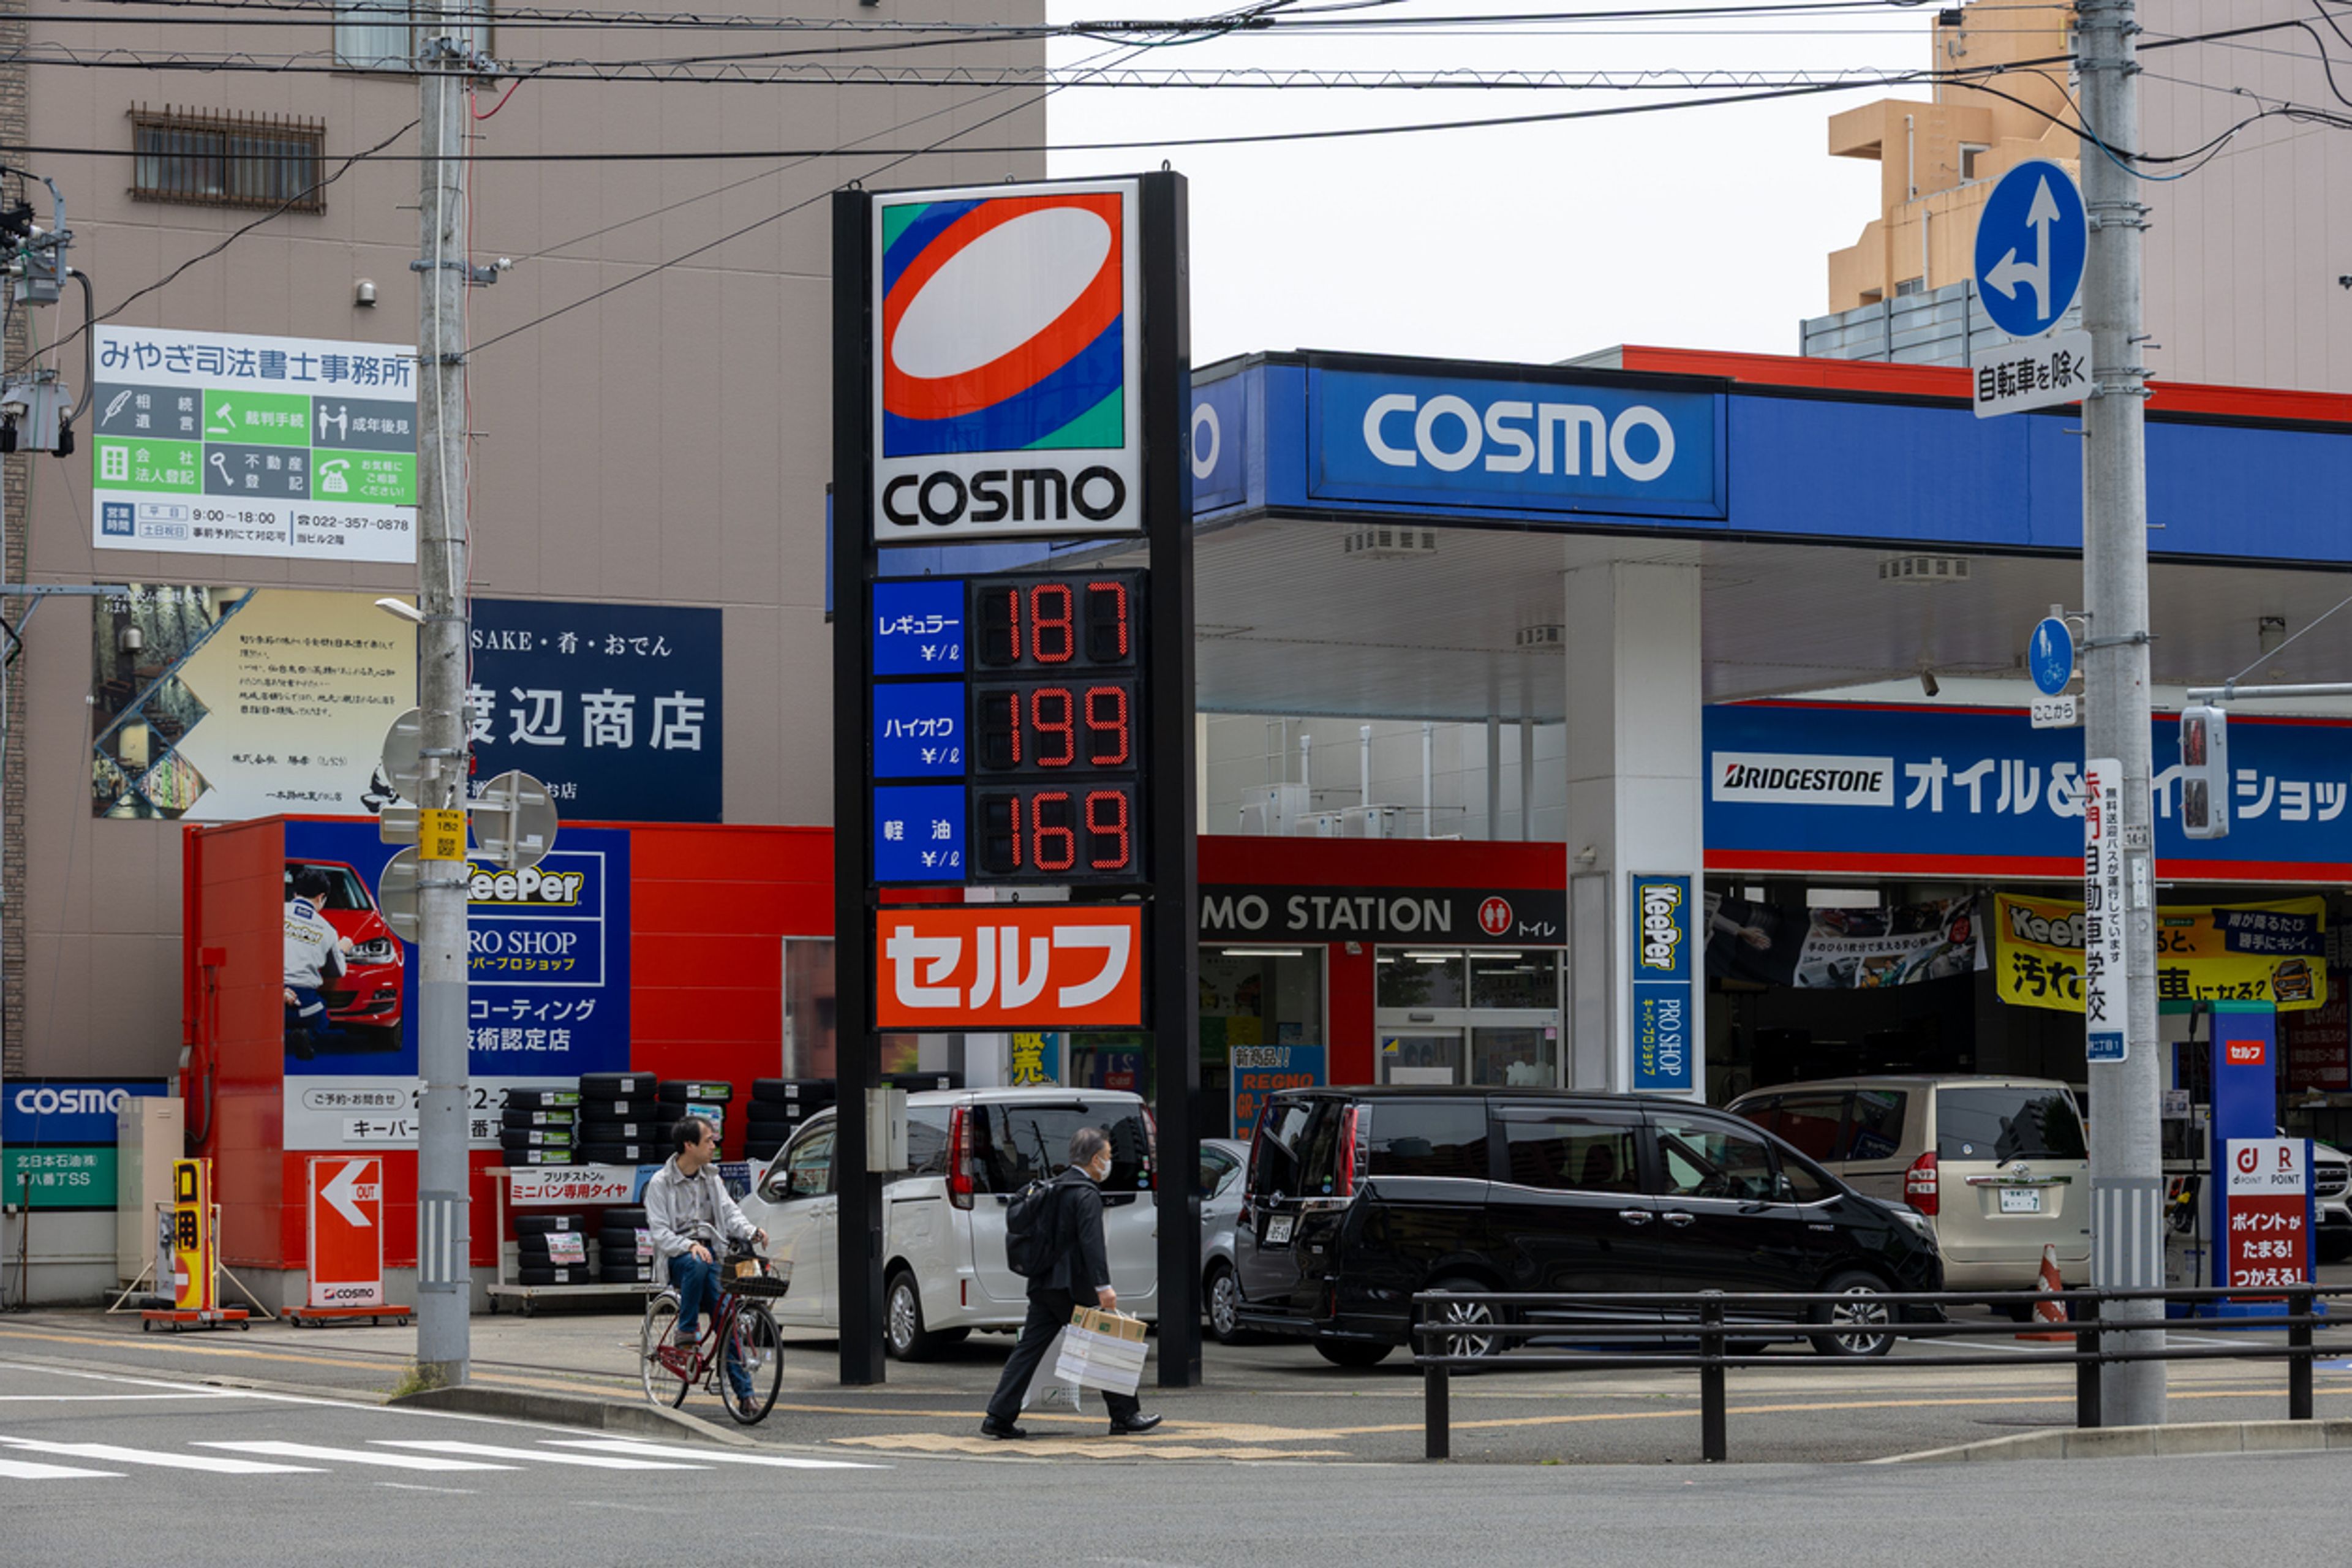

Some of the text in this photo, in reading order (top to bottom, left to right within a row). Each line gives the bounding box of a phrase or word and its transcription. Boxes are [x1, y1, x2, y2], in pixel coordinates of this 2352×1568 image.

[100, 339, 410, 388] みやぎ司法書士事務所
[1978, 349, 2085, 402] 自転車を除く
[246, 410, 304, 428] 裁判手続
[352, 418, 410, 434] 成年後見
[1362, 393, 1676, 481] COSMO
[135, 448, 194, 466] 会社
[246, 453, 303, 472] 不動産
[361, 460, 403, 472] お気軽に
[135, 467, 195, 485] 法人登記
[246, 473, 303, 491] 登記
[366, 473, 398, 484] ご相談
[882, 465, 1126, 527] COSMO
[312, 515, 409, 532] 022-357-0878
[879, 615, 959, 636] レギュラー
[1009, 581, 1128, 663] 187
[2033, 703, 2073, 722] ここから
[884, 718, 954, 738] ハイオク
[1010, 686, 1128, 767] 199
[1723, 763, 1883, 793] BRIDGESTONE
[884, 819, 951, 841] 軽油
[1010, 790, 1129, 870] 169
[1200, 894, 1452, 932] MO STATION
[1518, 921, 1556, 937] トイレ
[1643, 886, 1679, 969] KeePer
[2008, 905, 2086, 949] KeeP
[467, 930, 578, 955] RO SHOP
[886, 924, 1131, 1009] セルフ
[2012, 952, 2081, 1000] 汚れ
[470, 997, 597, 1022] コーティング
[1658, 999, 1681, 1077] PRO SHOP
[1235, 1047, 1291, 1068] 新商品!!
[2230, 1046, 2261, 1060] セルフ
[1242, 1072, 1314, 1090] REGNO
[467, 1087, 510, 1110] 2-2
[2271, 1174, 2301, 1185] POINT
[356, 1185, 375, 1199] OUT
[511, 1184, 627, 1200] ミニバン専用タイヤ
[2231, 1212, 2301, 1231] ポイントが
[2242, 1240, 2293, 1259] たまる!
[2234, 1268, 2302, 1287] つかえる!
[336, 1287, 374, 1300] COSMO
